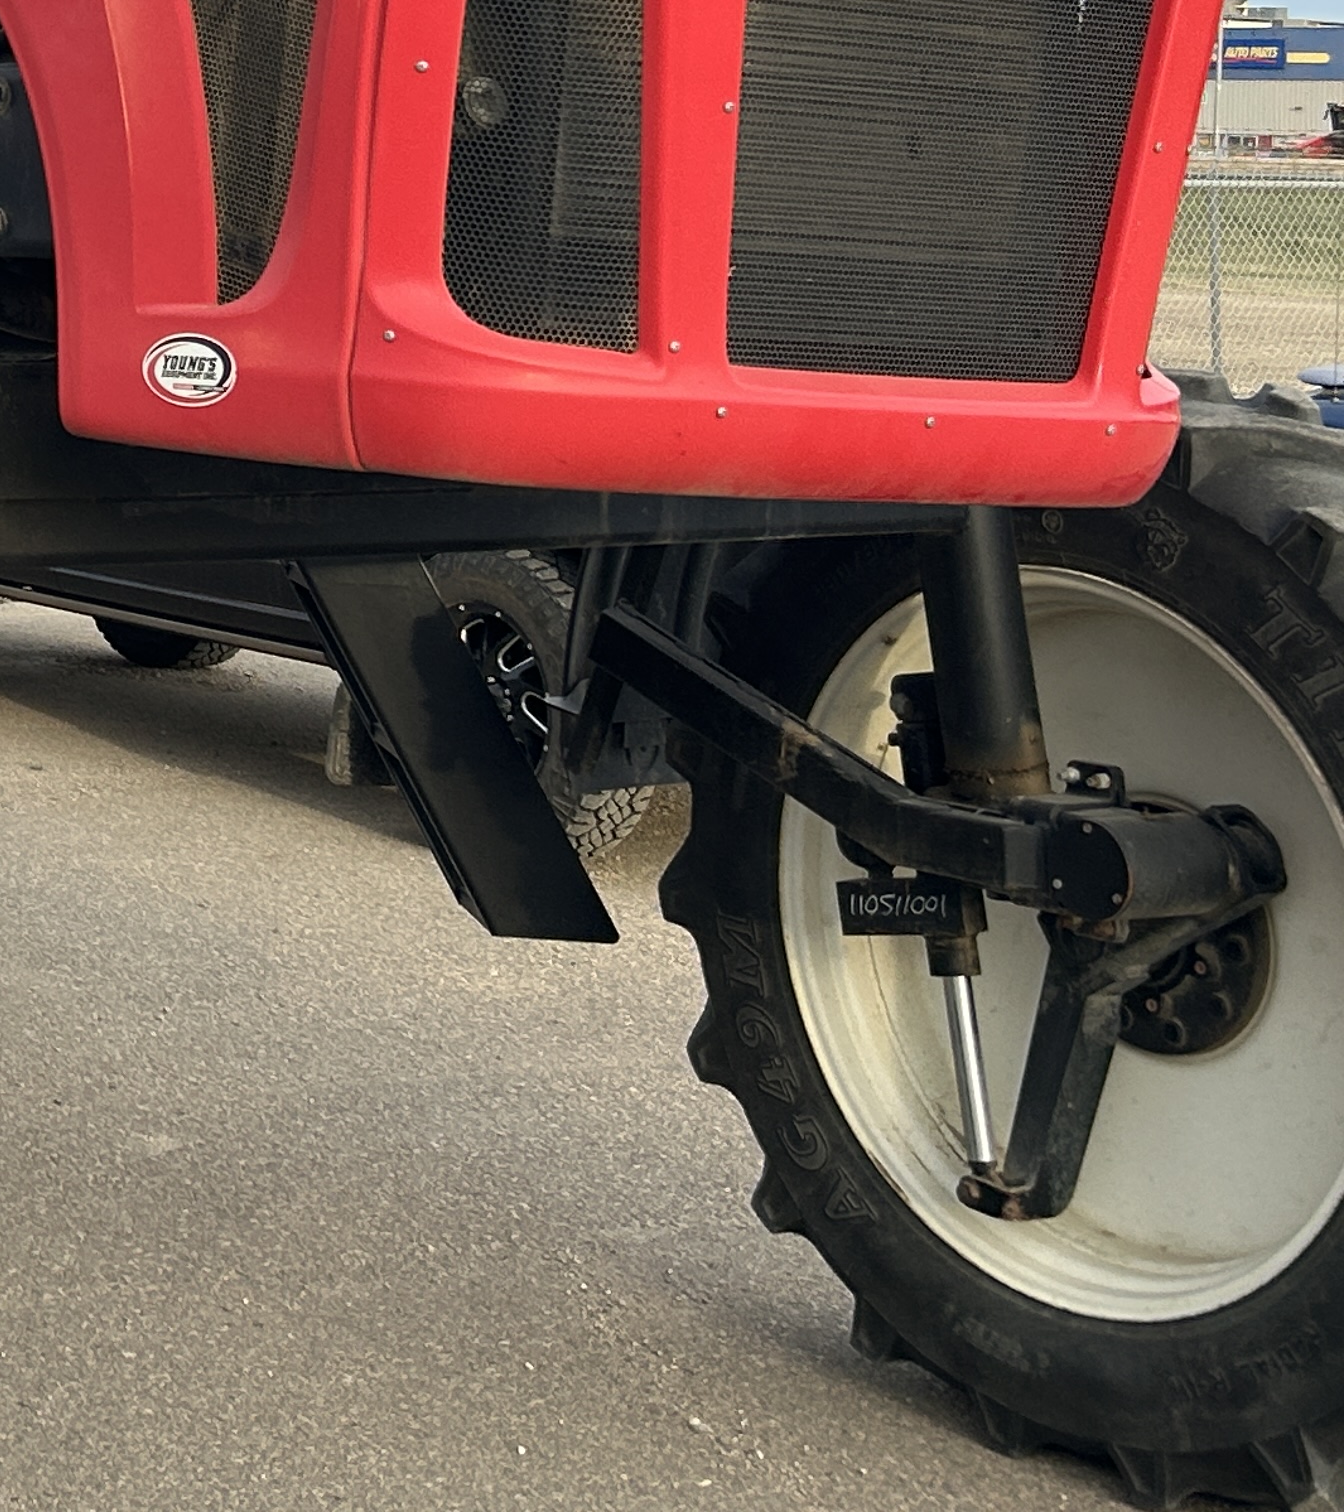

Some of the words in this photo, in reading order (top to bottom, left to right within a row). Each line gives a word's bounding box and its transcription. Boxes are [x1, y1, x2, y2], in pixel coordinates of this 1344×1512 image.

[1223, 46, 1249, 58] AUTO
[1250, 46, 1279, 58] PARTS
[162, 354, 218, 372] YOUNG'S
